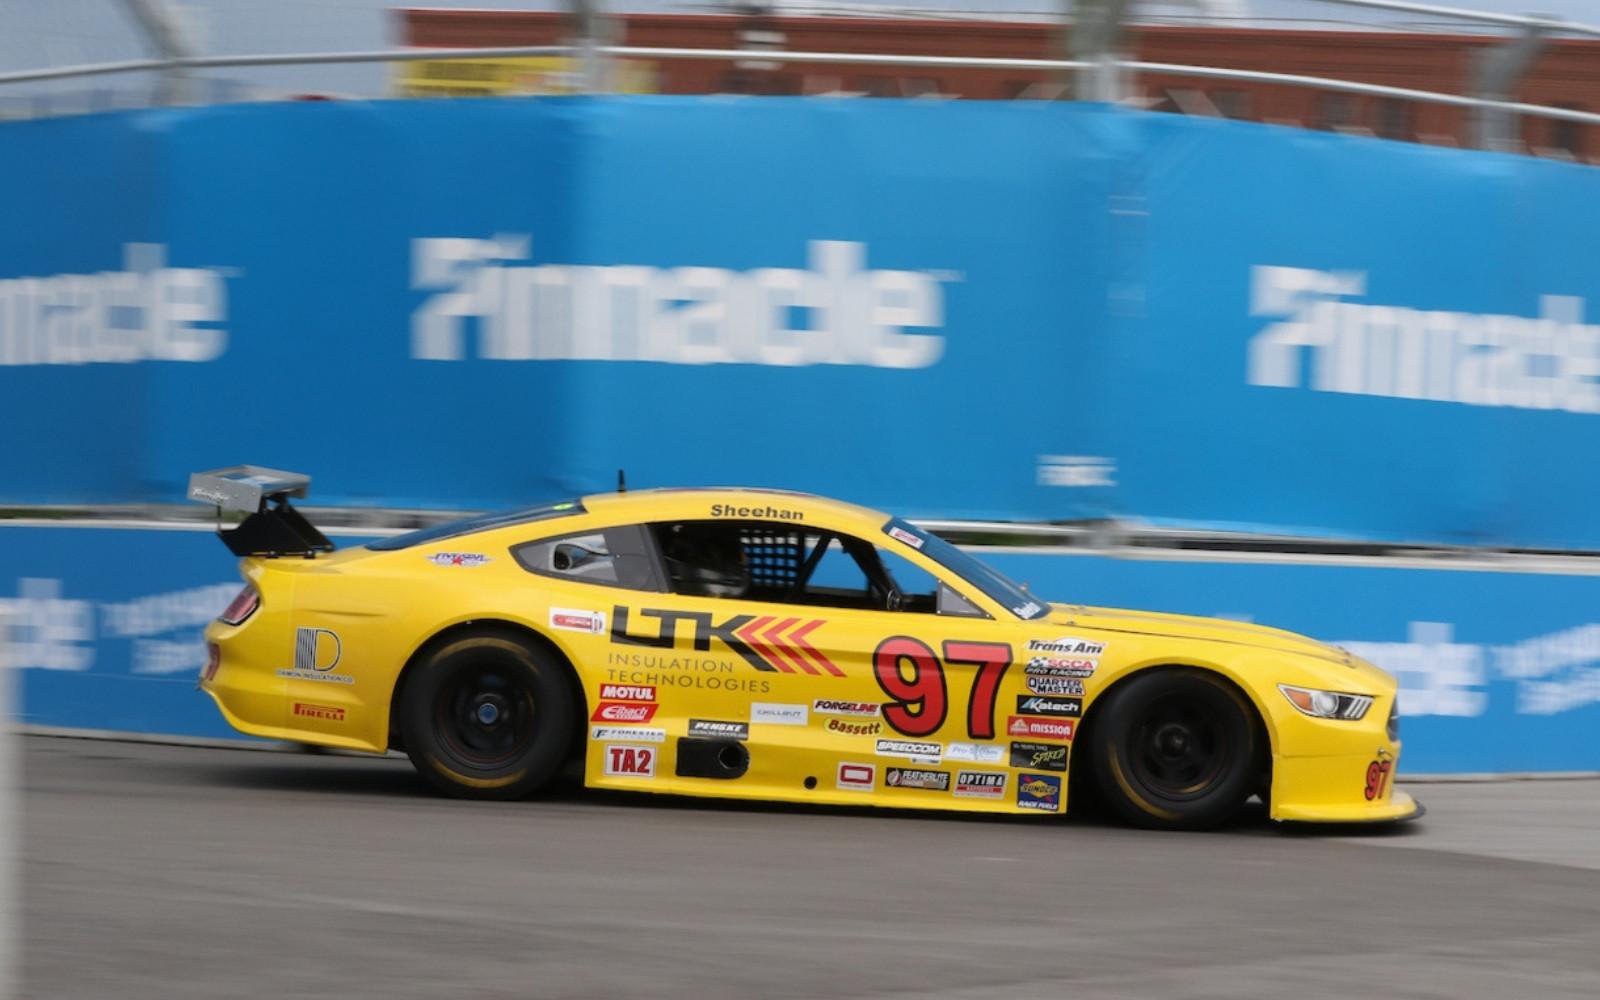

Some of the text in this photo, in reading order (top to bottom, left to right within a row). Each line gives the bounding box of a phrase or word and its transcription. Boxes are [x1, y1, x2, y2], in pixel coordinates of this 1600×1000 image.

[711, 504, 804, 520] Sheehan
[610, 605, 779, 673] LTK
[1029, 640, 1103, 654] Trans Am
[608, 652, 734, 673] INSULATION
[1047, 658, 1093, 669] SCCA
[1026, 667, 1092, 677] PRO RACING
[608, 669, 770, 693] TECHNOLOGIES
[872, 635, 1013, 740] 97
[1028, 676, 1081, 687] QUARTER
[602, 686, 653, 700] MOTUL
[1037, 684, 1083, 694] MASTER
[294, 703, 345, 720] PIRELLI
[815, 700, 880, 712] FORGELINE
[1029, 698, 1079, 713] Katech
[694, 722, 743, 732] PENSKE
[829, 719, 881, 735] Bassett
[878, 740, 940, 754] SPEEDCOM
[610, 748, 651, 774] TA2
[902, 771, 949, 783] FEATHERLITE
[959, 769, 1004, 781] OPTIMA
[1364, 760, 1392, 801] 97
[1022, 784, 1057, 793] SUNOCO
[1018, 800, 1038, 809] RACE
